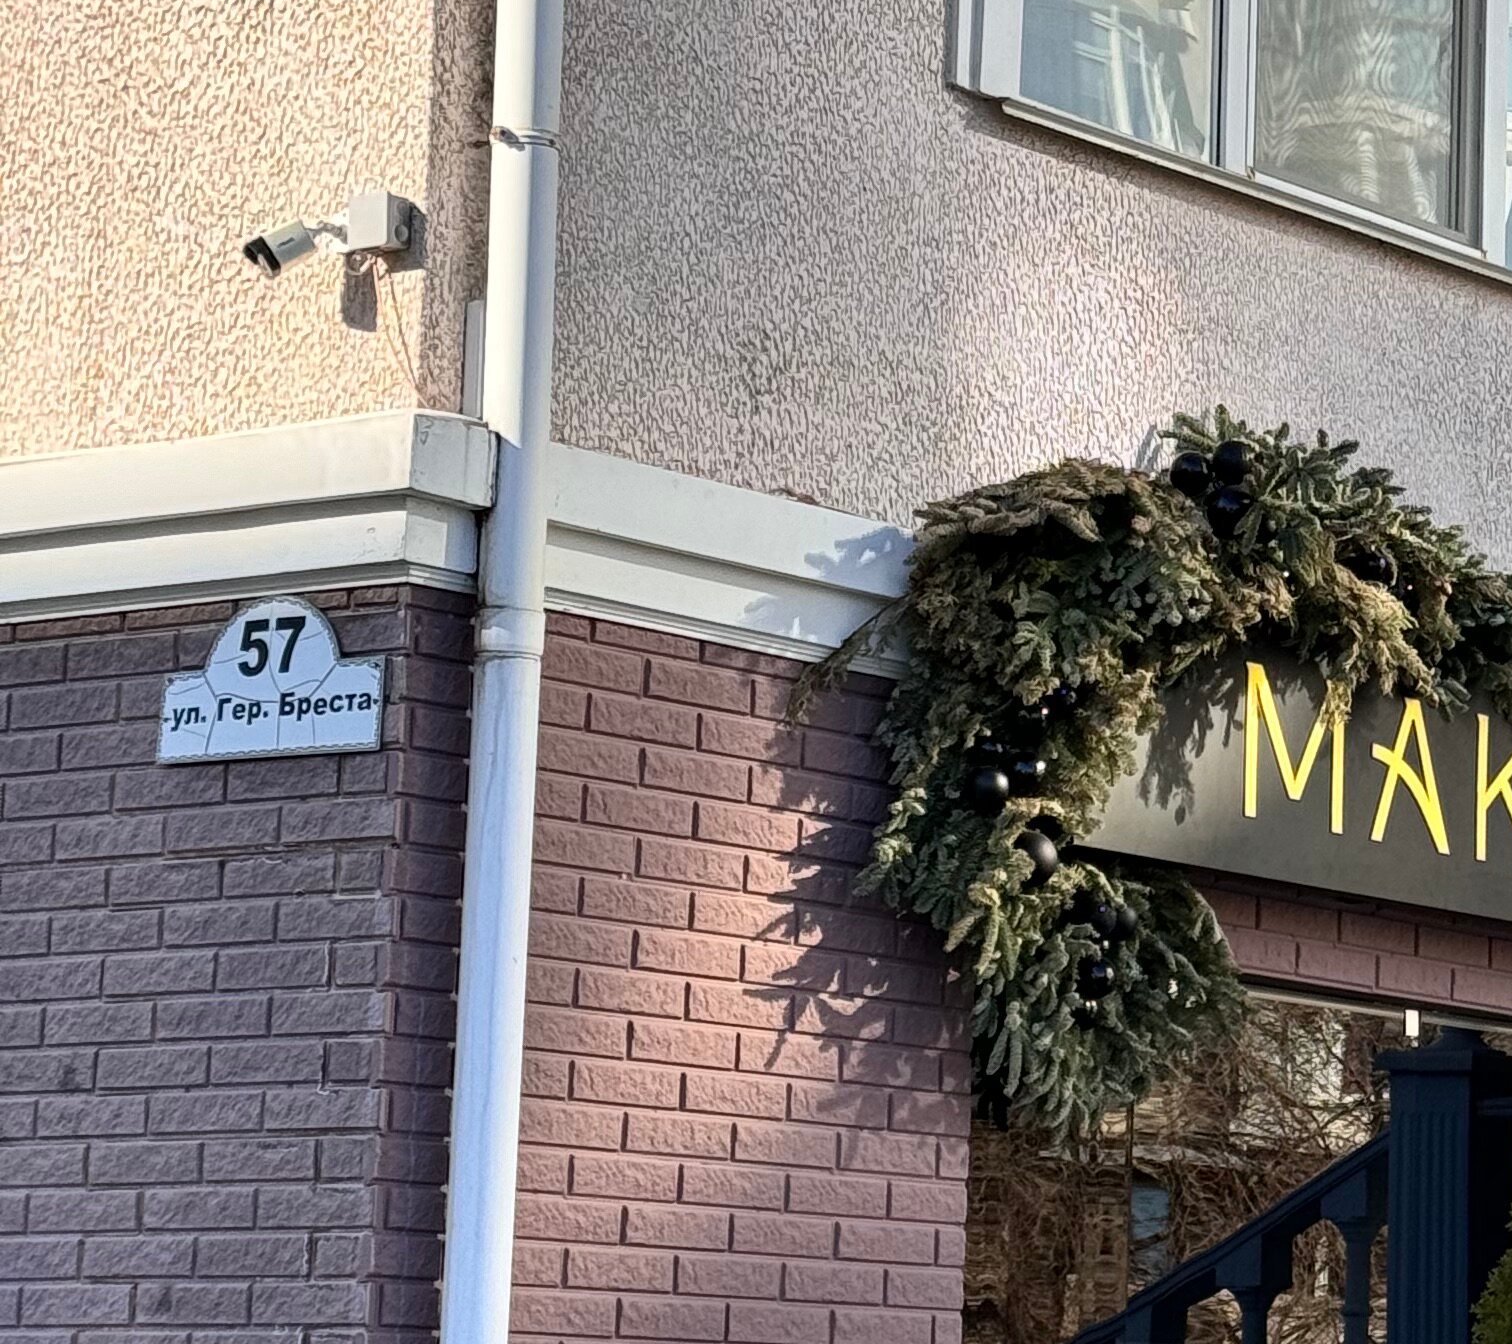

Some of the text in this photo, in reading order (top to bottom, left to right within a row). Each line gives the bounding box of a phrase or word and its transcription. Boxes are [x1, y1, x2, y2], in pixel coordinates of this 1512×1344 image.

[237, 615, 306, 677] 57
[171, 691, 372, 731] ул. Гер. Бреста
